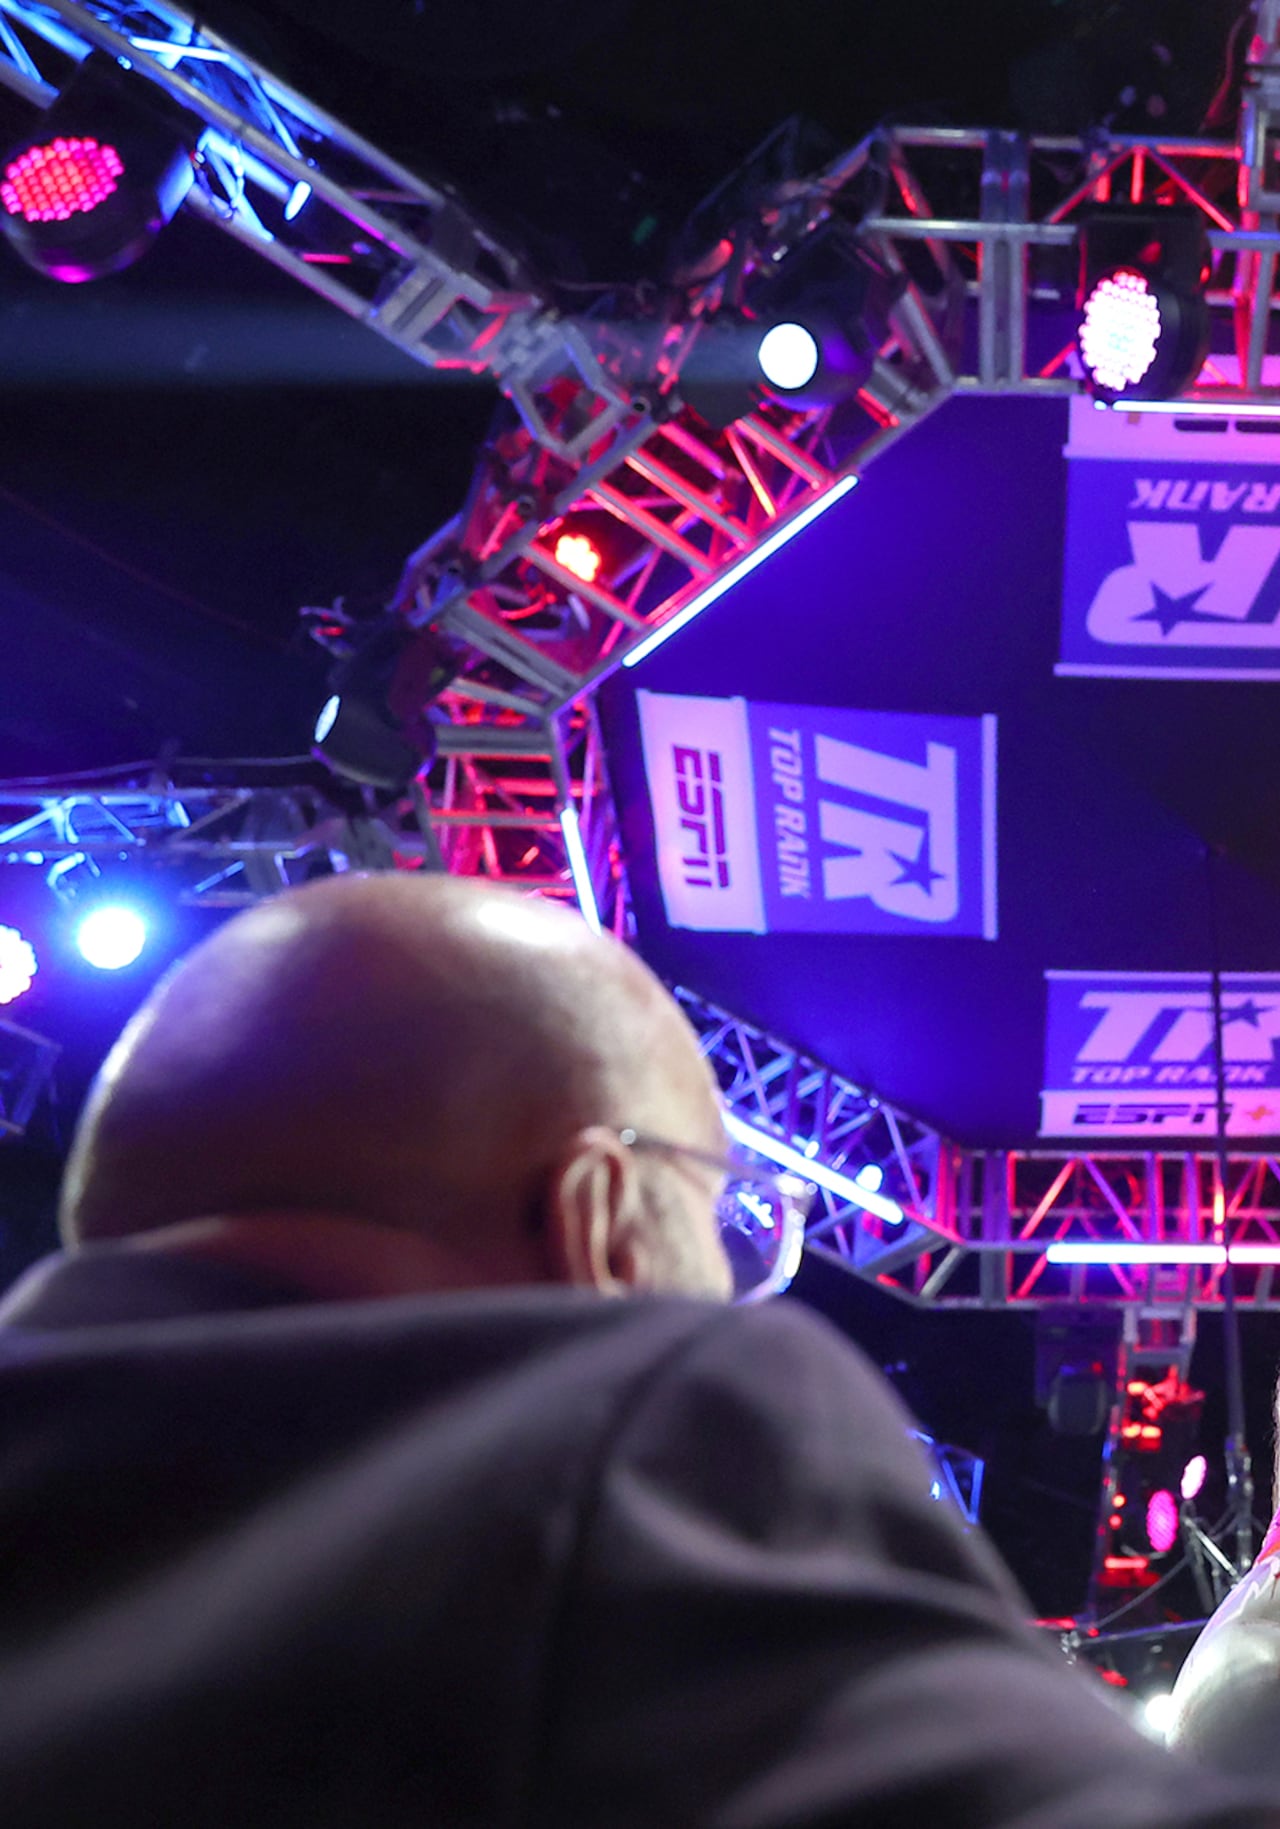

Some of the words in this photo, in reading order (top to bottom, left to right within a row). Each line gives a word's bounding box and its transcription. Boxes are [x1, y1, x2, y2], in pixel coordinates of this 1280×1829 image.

[768, 727, 806, 800] TOP
[671, 743, 731, 890] ESPN
[774, 803, 811, 900] RANK
[814, 732, 960, 923] TR
[1071, 1066, 1151, 1084] TOP
